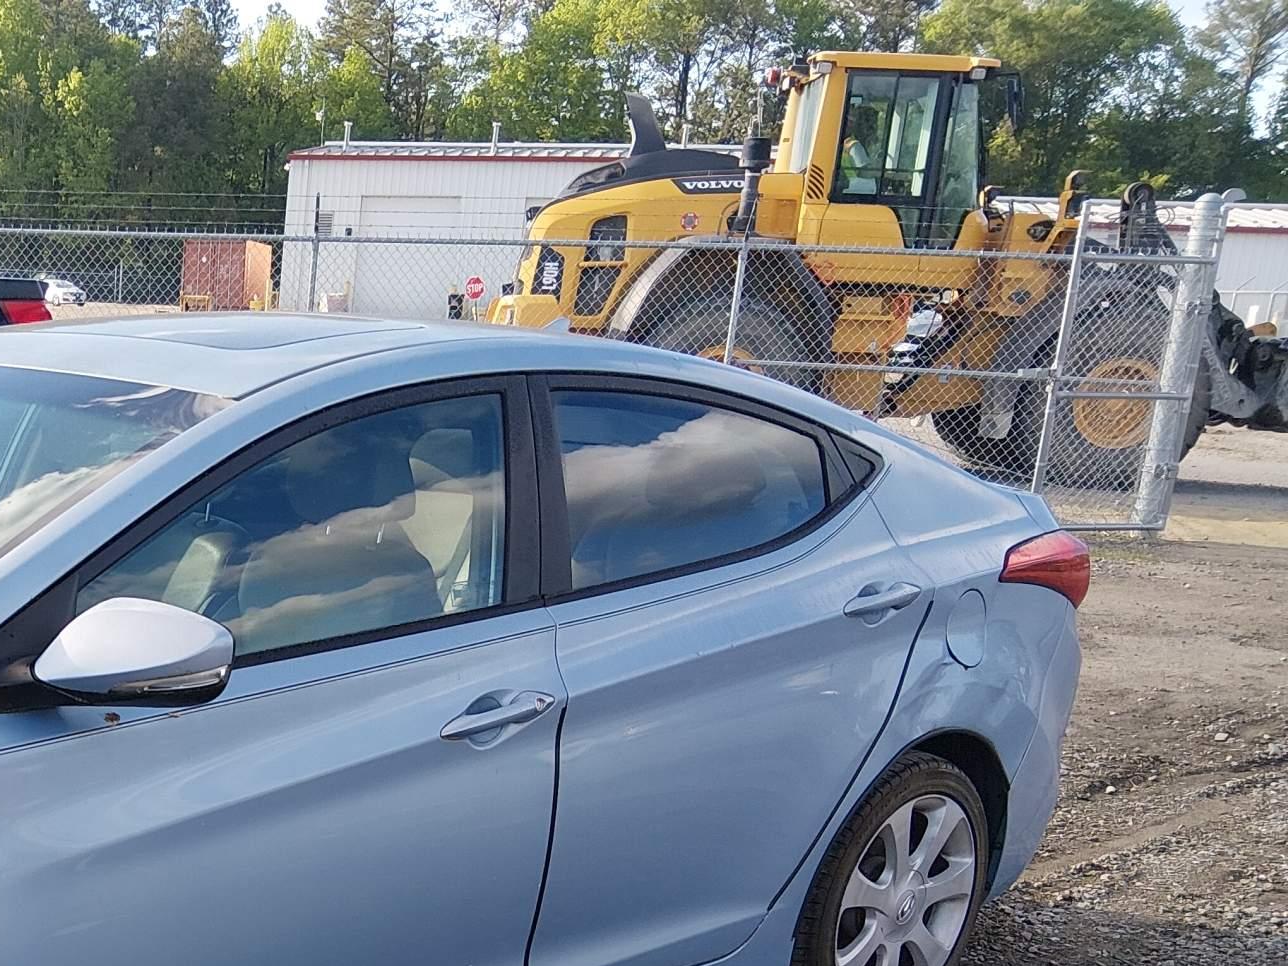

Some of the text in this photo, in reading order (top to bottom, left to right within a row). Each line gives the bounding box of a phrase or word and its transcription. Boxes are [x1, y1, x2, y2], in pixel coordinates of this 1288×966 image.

[682, 180, 745, 190] VOLVO
[541, 261, 560, 290] L90H
[467, 283, 484, 294] STOP
